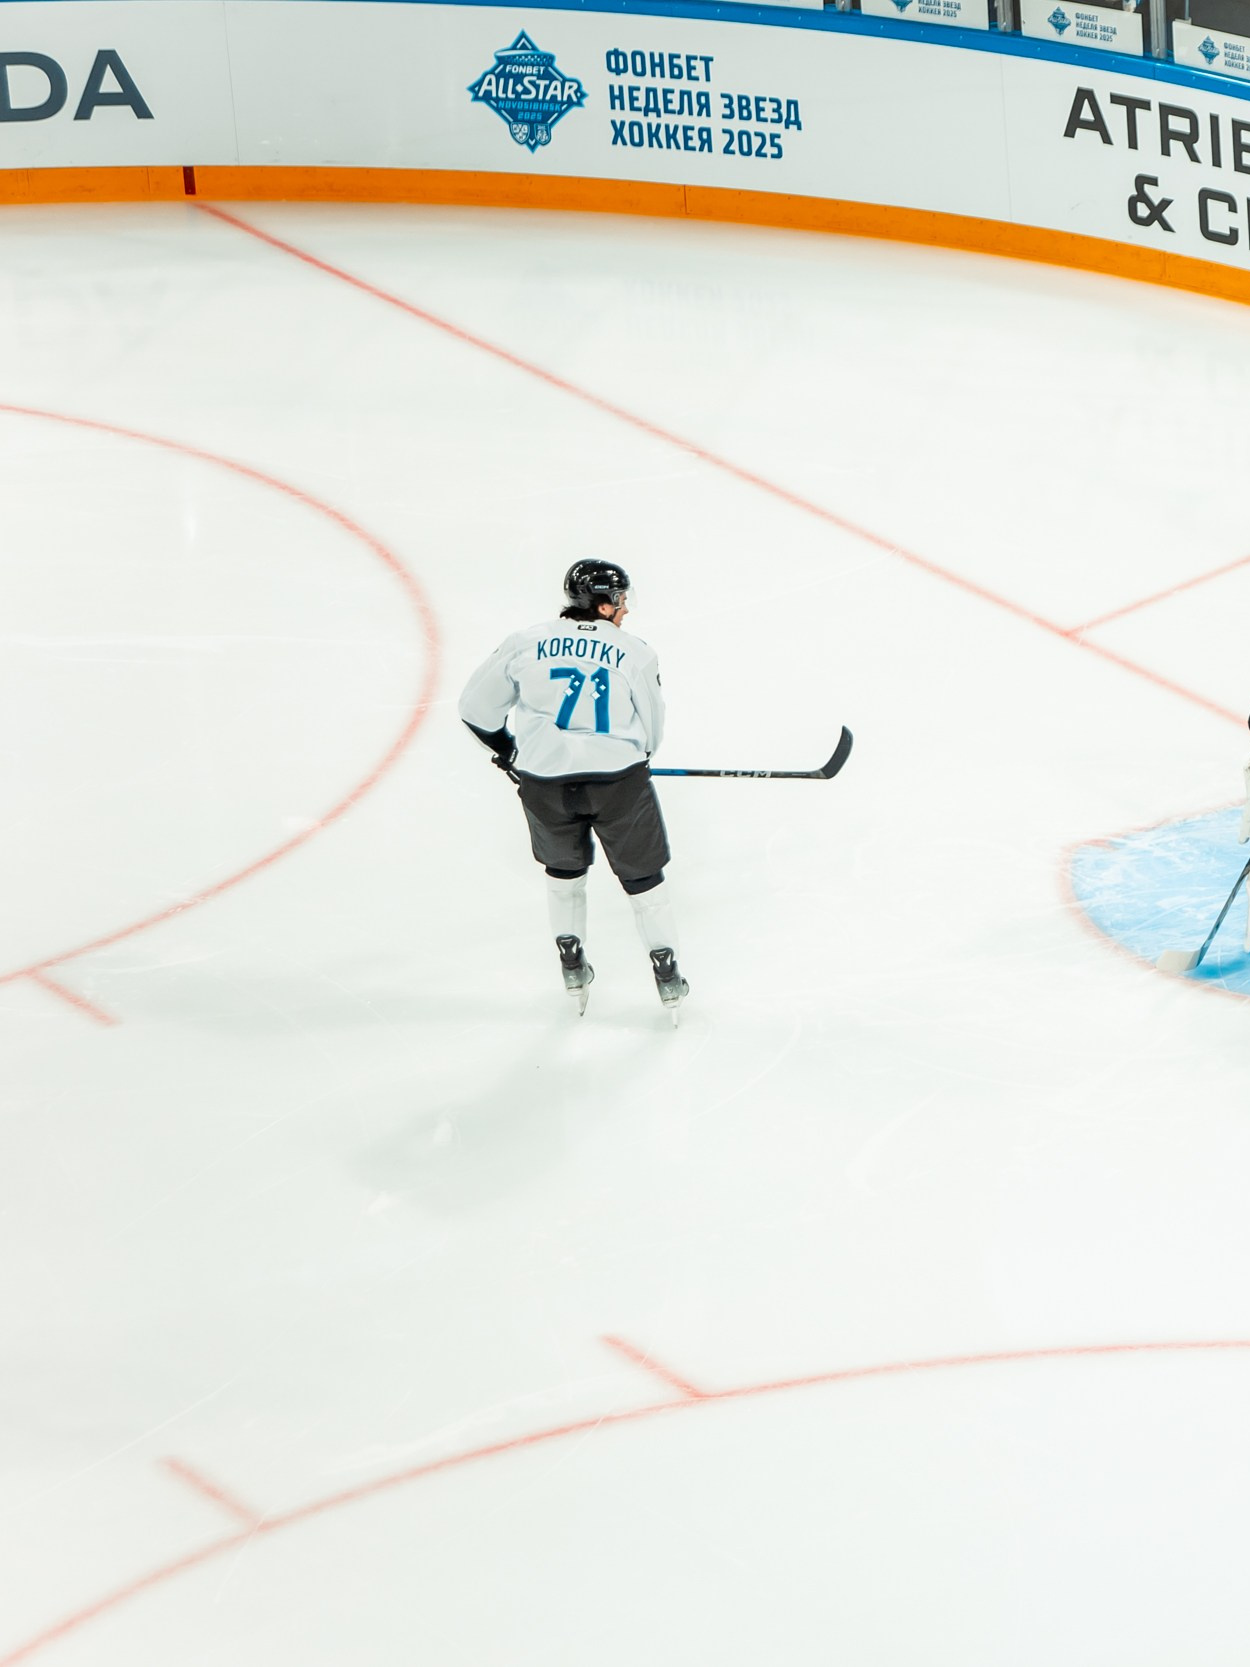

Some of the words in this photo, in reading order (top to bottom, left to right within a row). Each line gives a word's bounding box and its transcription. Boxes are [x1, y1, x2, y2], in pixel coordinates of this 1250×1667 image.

[505, 64, 545, 75] FONBET
[606, 48, 714, 82] ФОНБЕТ
[498, 101, 561, 112] NOVOSIBIRSK
[517, 111, 542, 120] 2025
[609, 84, 711, 118] НЕДЕЛЯ
[720, 93, 802, 131] ЗВЕЗД
[610, 119, 713, 153] ХОККЕЯ
[722, 128, 783, 159] 2025
[1127, 173, 1175, 233] &
[537, 637, 626, 669] KOROTKY
[549, 666, 611, 734] 71
